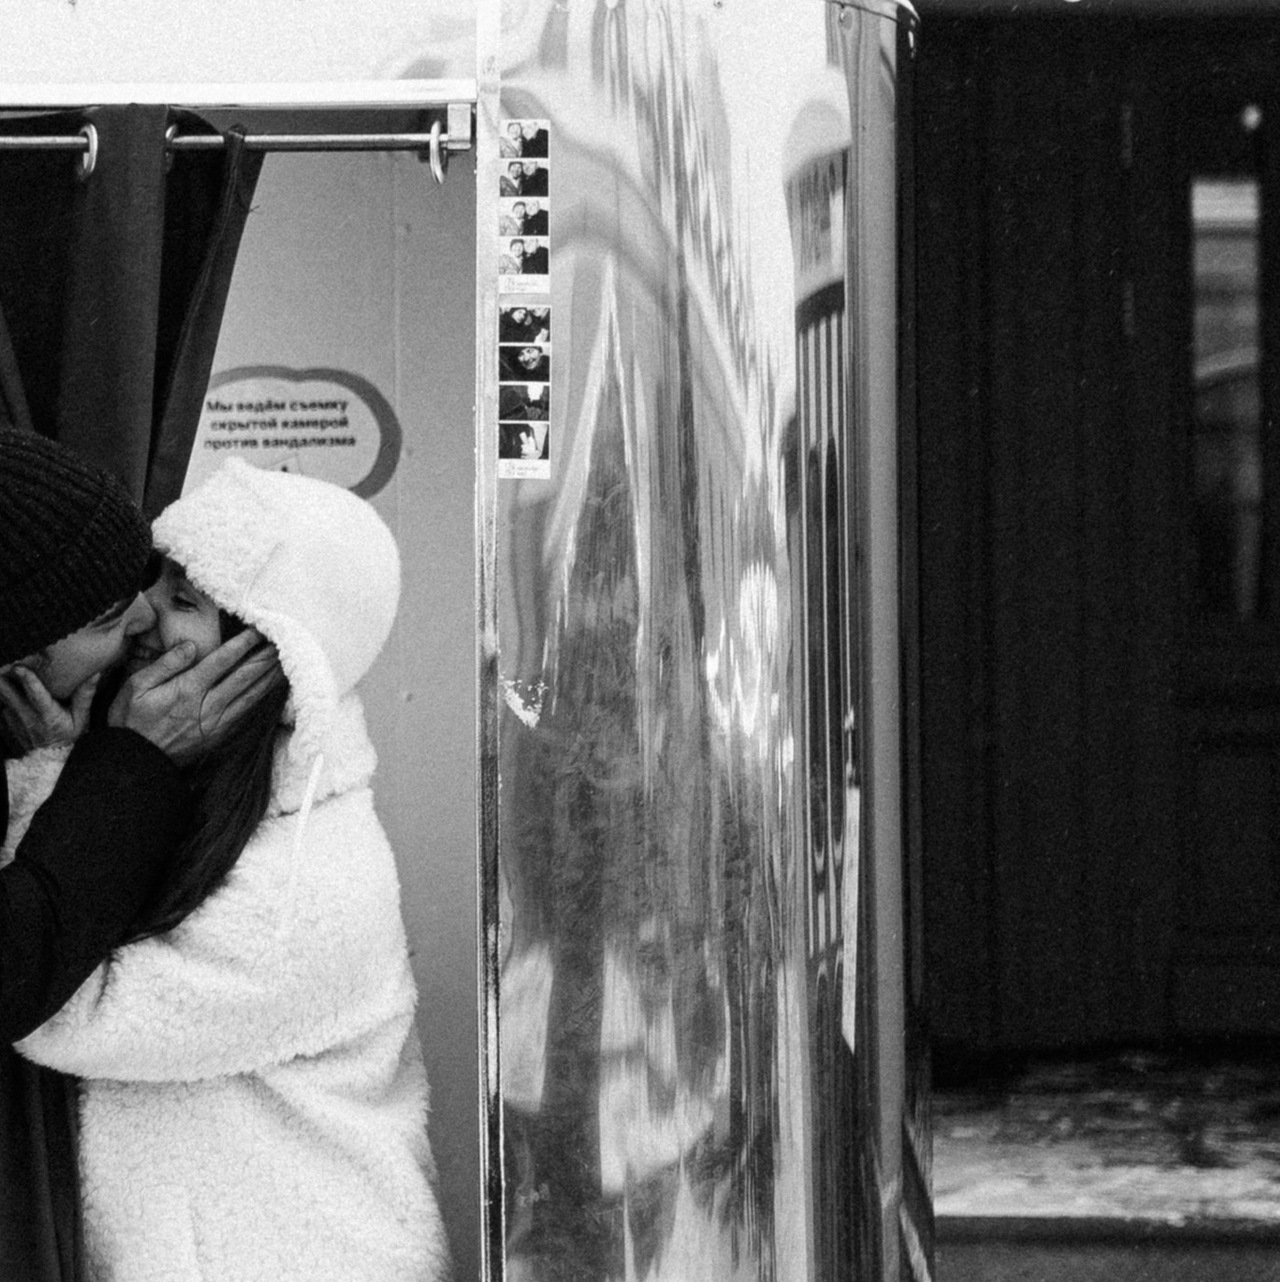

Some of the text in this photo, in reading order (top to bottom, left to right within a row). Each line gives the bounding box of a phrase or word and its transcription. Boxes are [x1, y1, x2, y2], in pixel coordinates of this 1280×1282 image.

[206, 400, 233, 412] Мы
[210, 416, 350, 432] скрытой камерой
[204, 436, 356, 451] против вандализма
